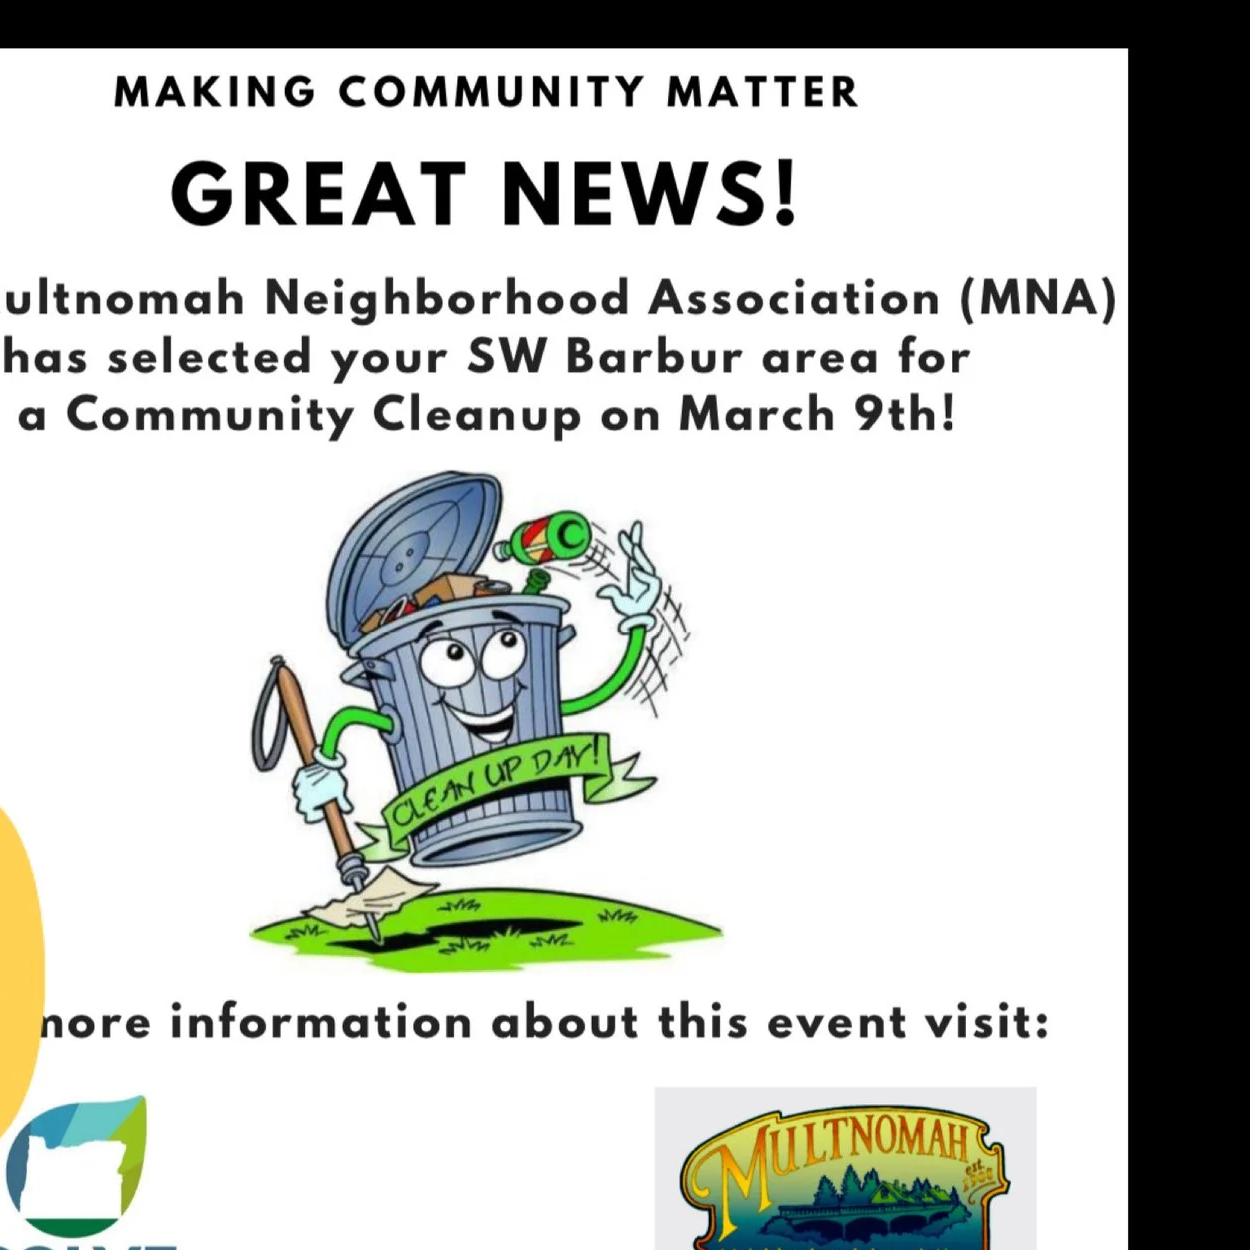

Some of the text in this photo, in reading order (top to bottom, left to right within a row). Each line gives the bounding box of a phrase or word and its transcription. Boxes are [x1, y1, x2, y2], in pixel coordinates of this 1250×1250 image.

[114, 74, 859, 108] MAKING COMMUNITY MATTER
[171, 158, 795, 227] GREAT NEWS!
[266, 276, 628, 326] Neighborhood
[647, 278, 939, 315] Association
[960, 276, 1116, 326] (MNA)
[3, 334, 971, 383] has selected your SW Barbur area for
[18, 392, 953, 442] a Community Cleanup on March 9th!
[392, 734, 600, 828] CLEAN UP DAY!
[171, 999, 471, 1039] information
[491, 1000, 638, 1039] about
[658, 1000, 747, 1039] this
[767, 1006, 906, 1039] event
[924, 1001, 1048, 1039] visit:
[691, 1113, 970, 1243] MULTNOMAH
